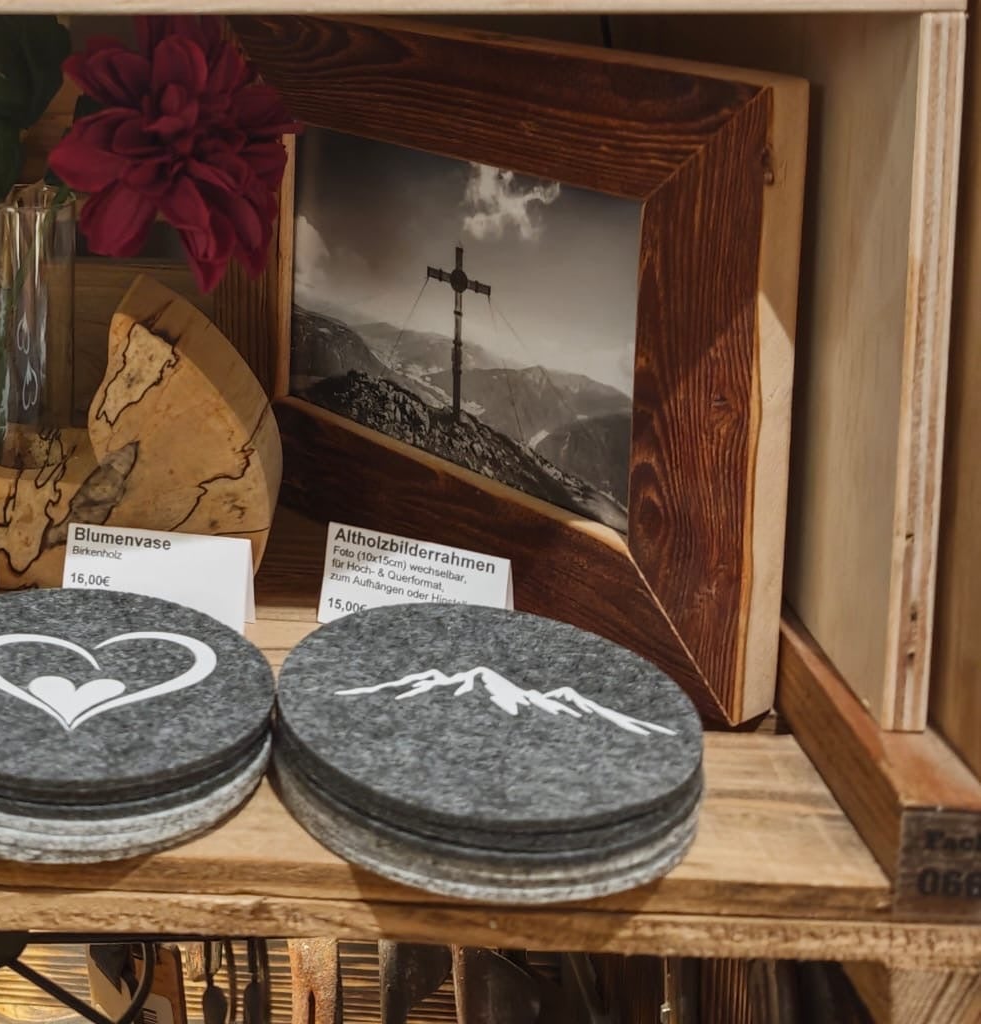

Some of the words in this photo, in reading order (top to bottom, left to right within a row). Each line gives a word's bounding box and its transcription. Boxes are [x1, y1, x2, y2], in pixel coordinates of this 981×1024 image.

[72, 545, 123, 560] Birkenholz
[74, 527, 172, 550] Blumenvase
[334, 528, 496, 574] Altholzbilderrahmen
[331, 558, 345, 569] für
[347, 561, 375, 575] Hoch-
[377, 567, 385, 578] &
[387, 570, 445, 593] Querformat,
[333, 545, 355, 558] Foto
[357, 551, 407, 571] (10x15cm)
[409, 562, 468, 584] wechselbar,
[70, 572, 111, 587] 16,00€
[330, 572, 351, 583] zum
[352, 576, 405, 595] Aufhängen
[406, 588, 429, 601] oder
